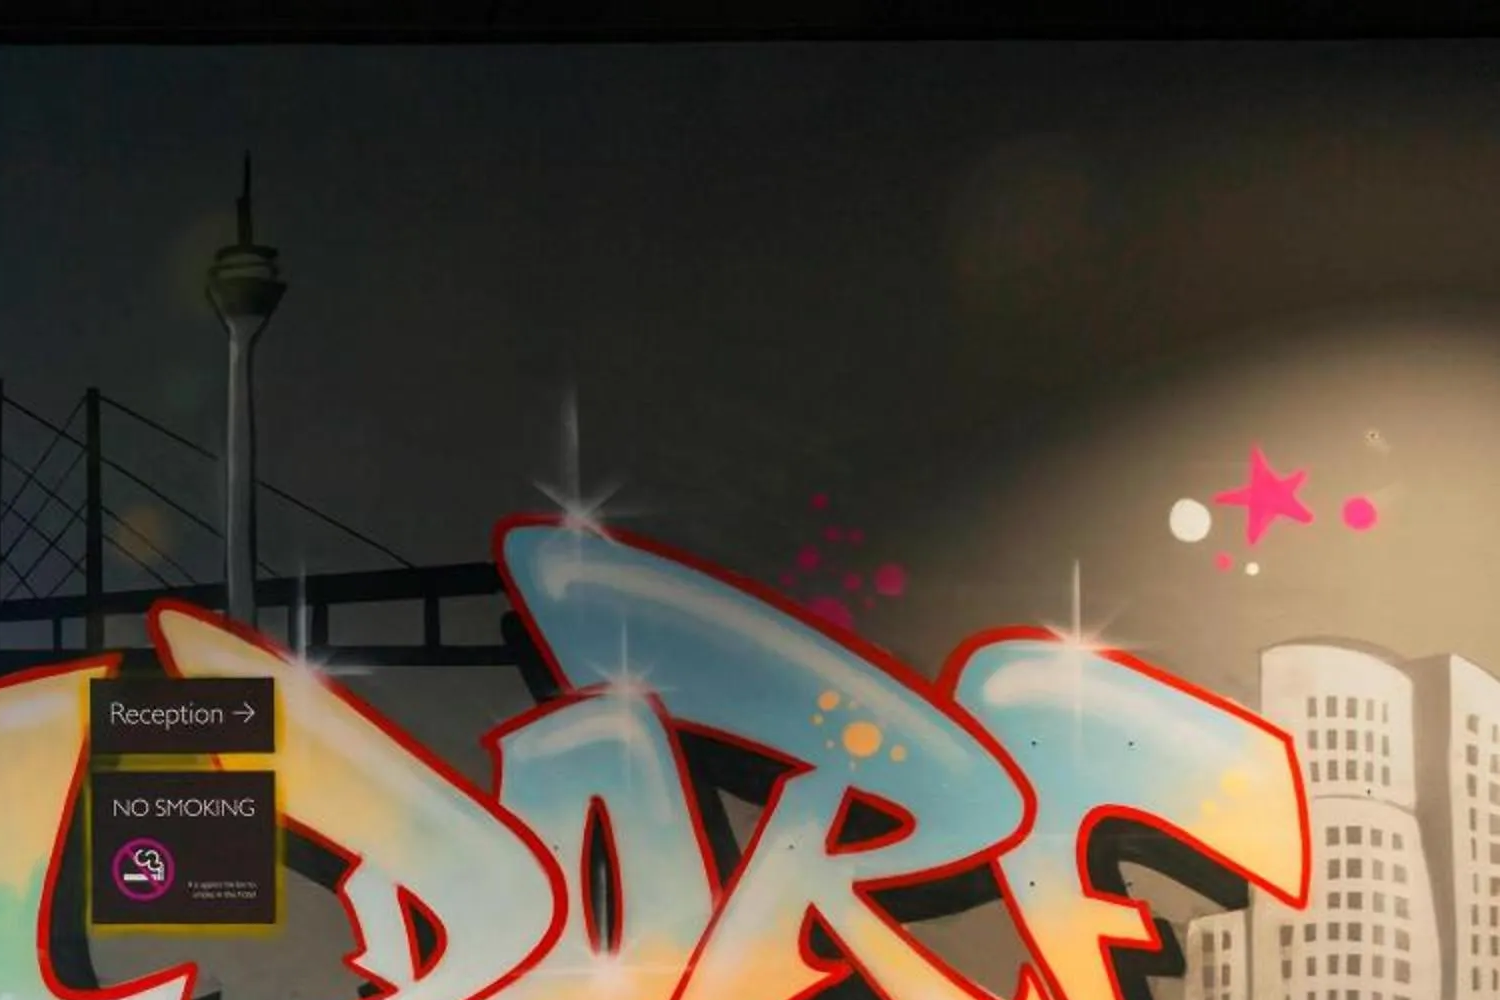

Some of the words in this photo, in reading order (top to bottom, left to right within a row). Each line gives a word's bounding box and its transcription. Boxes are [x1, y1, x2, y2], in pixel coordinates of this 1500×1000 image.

[110, 701, 224, 730] Reception
[113, 798, 150, 817] NO
[155, 798, 256, 817] SMOKING
